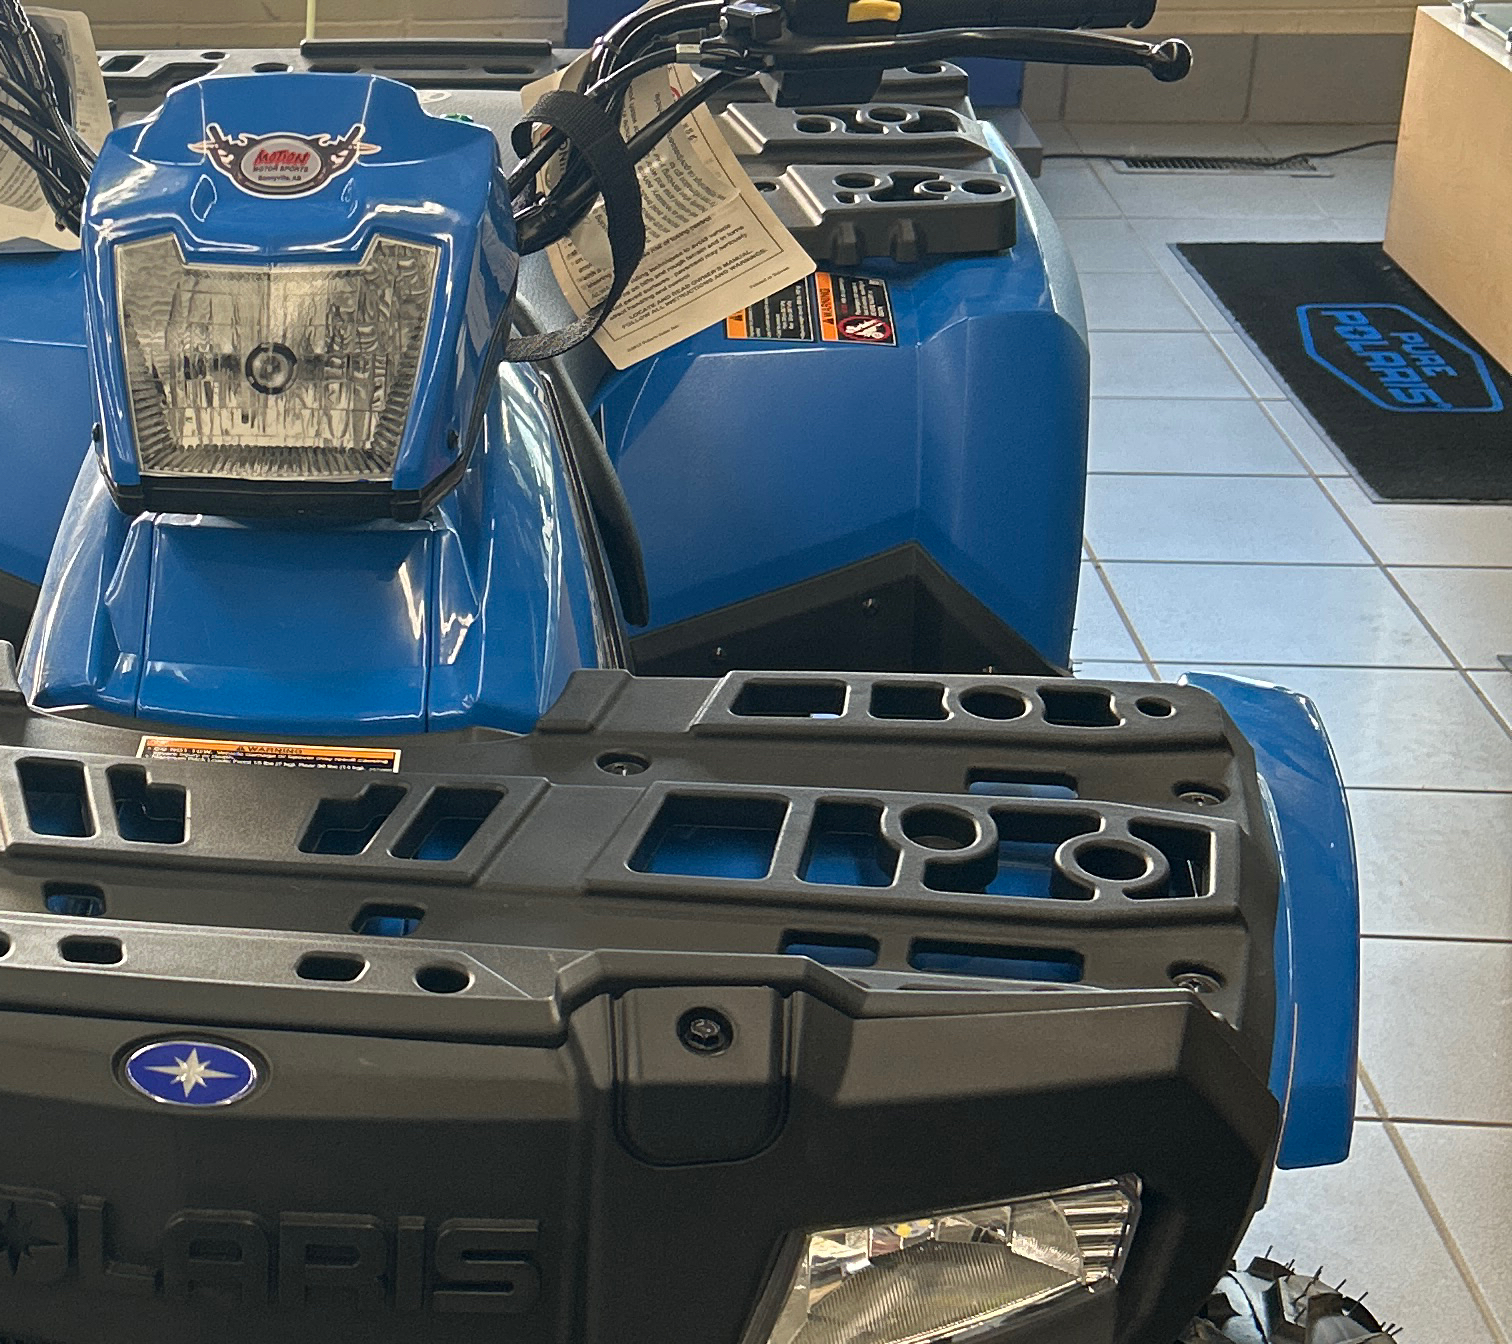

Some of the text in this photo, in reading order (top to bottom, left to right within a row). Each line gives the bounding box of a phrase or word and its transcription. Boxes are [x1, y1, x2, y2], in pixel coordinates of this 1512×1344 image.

[253, 148, 312, 166] MOTION
[820, 288, 832, 318] WARNING
[1321, 310, 1454, 411] POLARIS
[1389, 331, 1458, 378] PURE
[248, 746, 302, 754] WARNING
